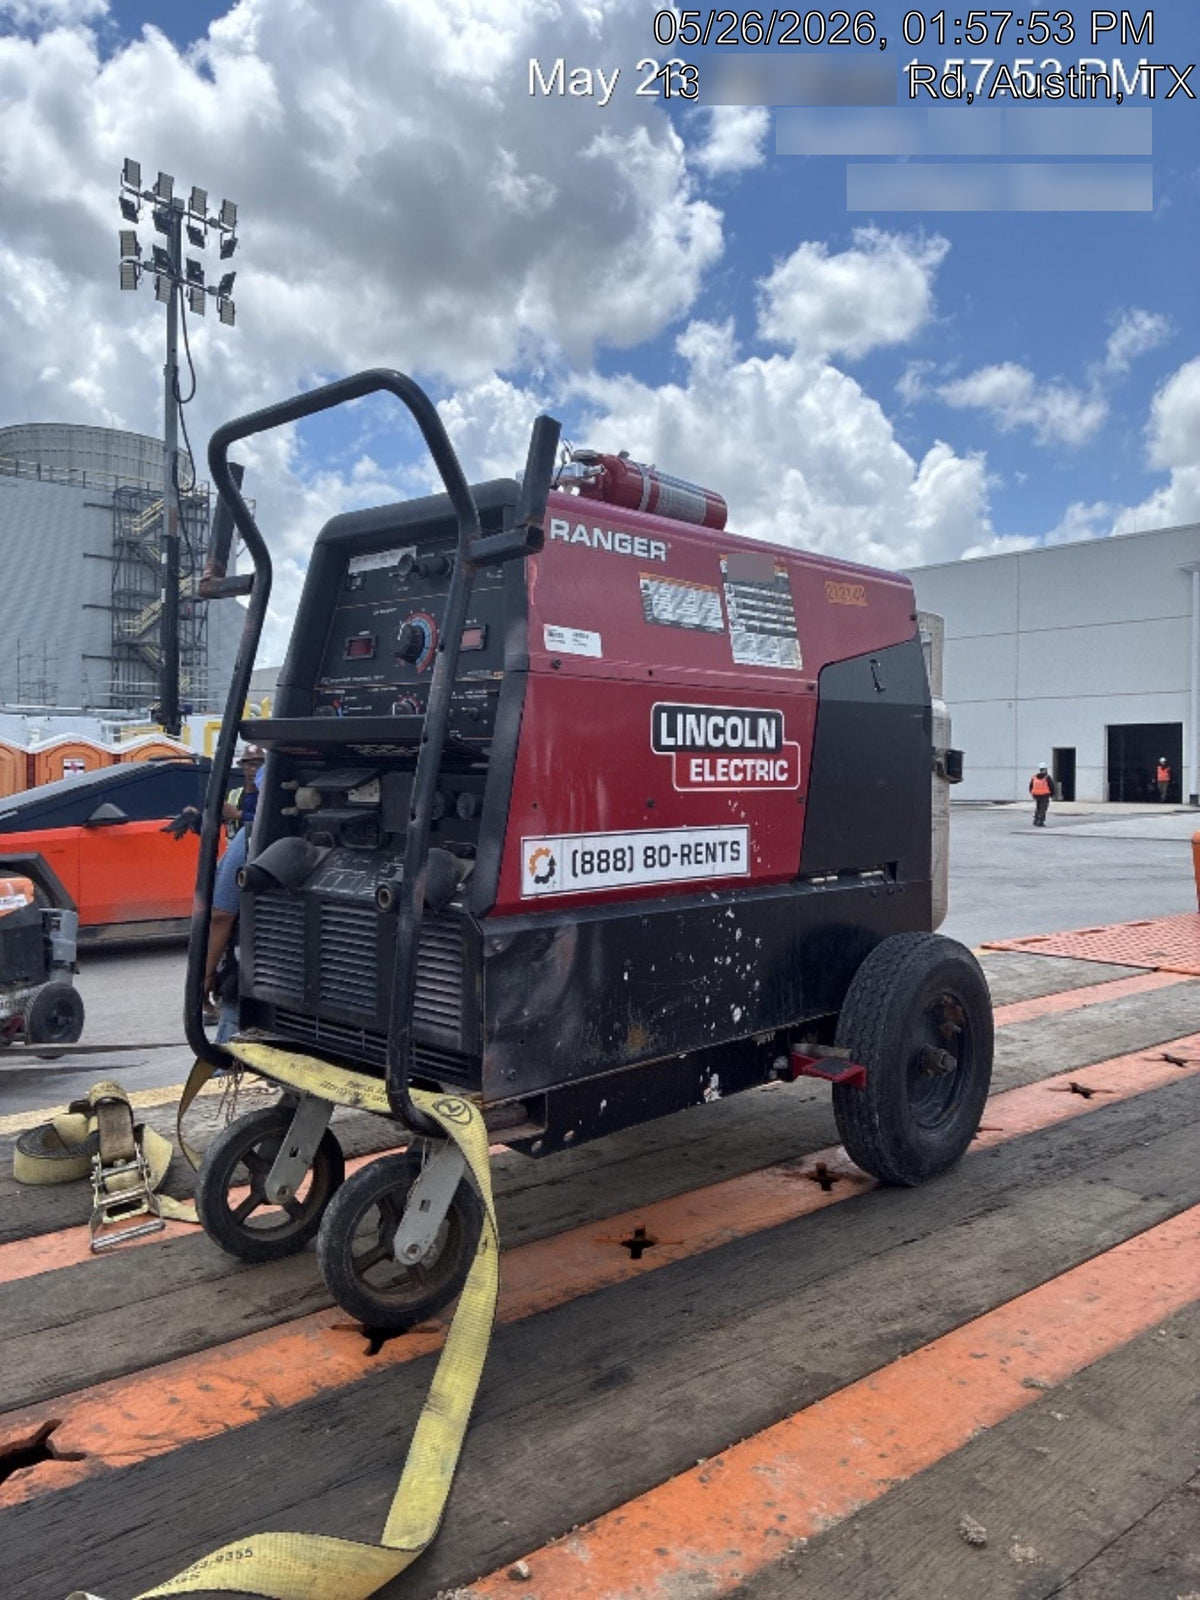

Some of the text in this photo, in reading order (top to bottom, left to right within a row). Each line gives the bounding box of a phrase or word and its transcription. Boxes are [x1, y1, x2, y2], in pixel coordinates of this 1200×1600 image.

[550, 518, 667, 562] RANGER
[660, 711, 777, 749] LINCOLN
[689, 757, 789, 782] ELECTRIC
[571, 839, 741, 877] (888) 80-RENTS
